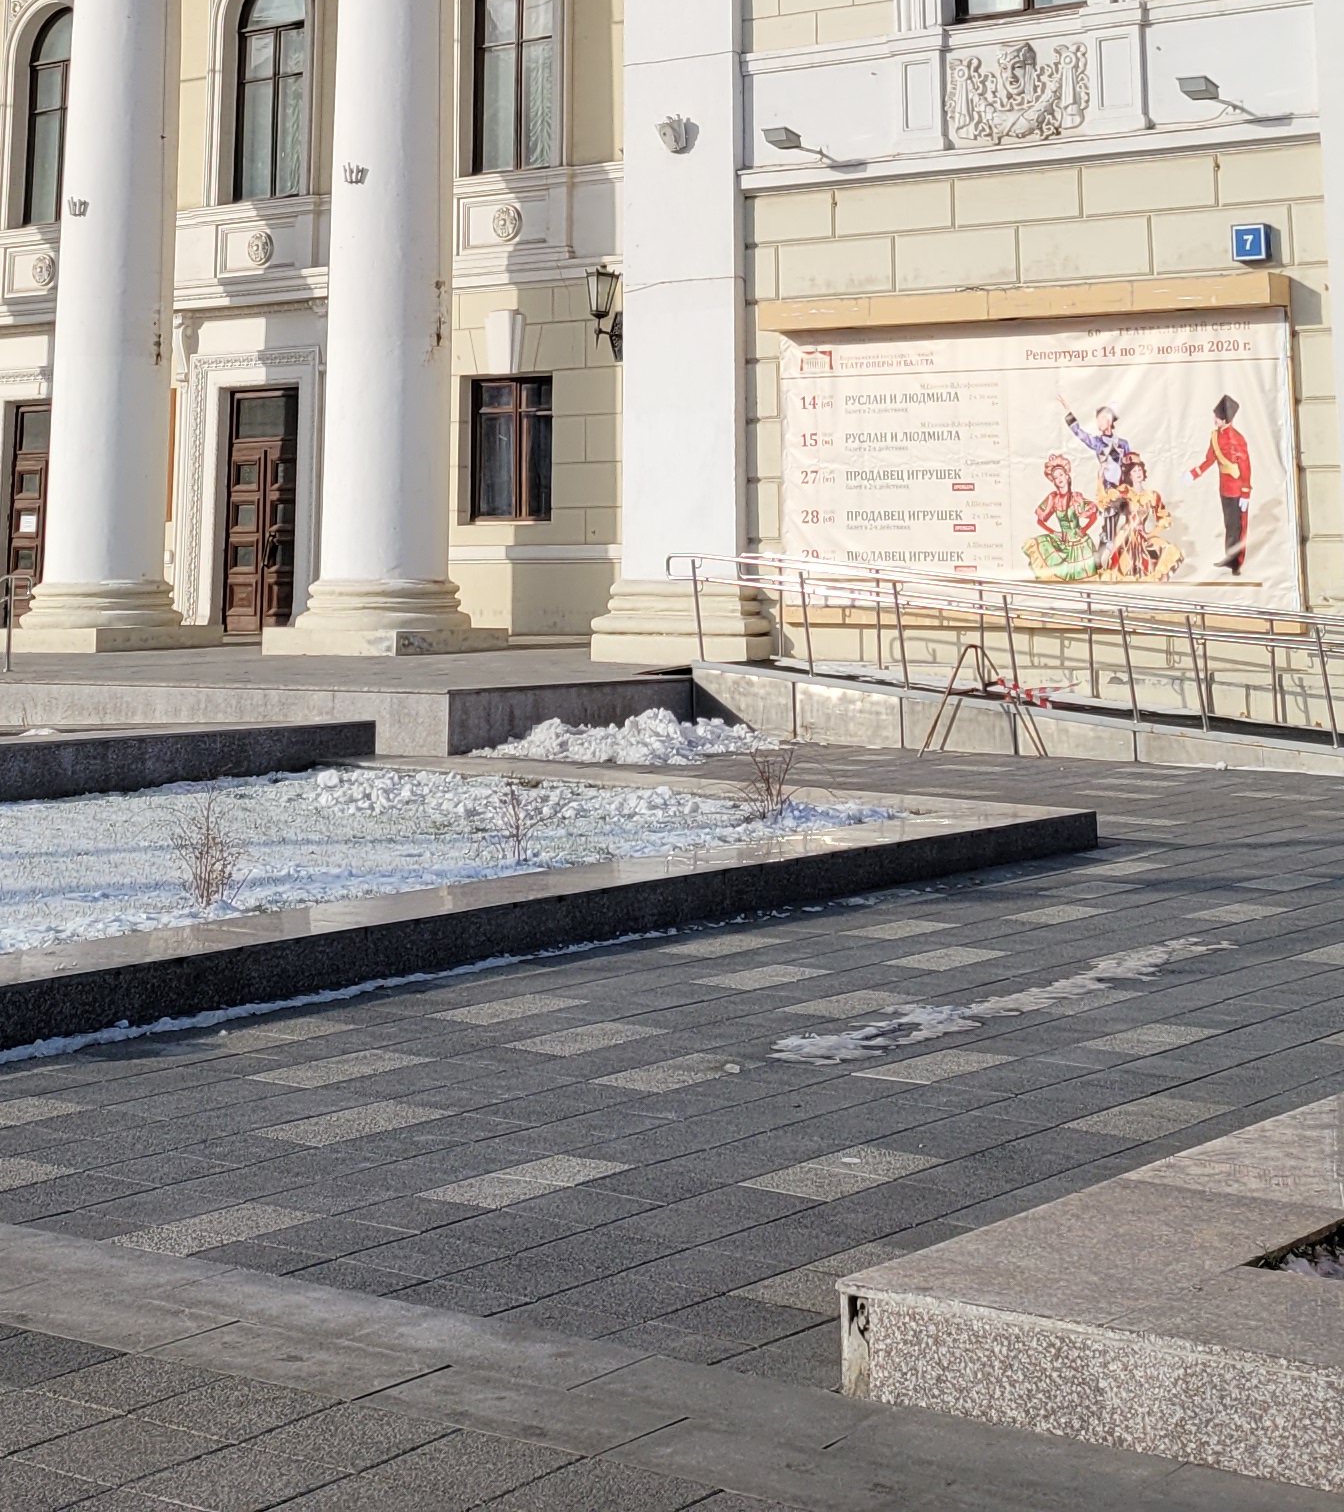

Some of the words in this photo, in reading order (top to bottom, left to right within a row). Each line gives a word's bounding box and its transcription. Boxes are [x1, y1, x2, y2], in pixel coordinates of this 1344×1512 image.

[1242, 234, 1254, 251] 7
[1211, 321, 1252, 332] СЕЗОН
[1025, 347, 1089, 362] Репертуар
[1091, 348, 1098, 358] с
[1101, 345, 1116, 358] 14
[1119, 347, 1136, 356] по
[1138, 344, 1153, 355] 29
[1157, 341, 1204, 357] ноября
[1207, 339, 1240, 353] 2020
[1243, 341, 1252, 351] г.
[839, 361, 864, 370] ТЕАТР
[866, 360, 894, 369] ОПЕРЫ
[896, 359, 902, 367] И
[903, 358, 935, 367] БАЛЕТА
[800, 395, 818, 409] 14
[845, 394, 887, 405] РУСЛАН
[890, 393, 897, 404] И
[900, 391, 960, 405] ЛЮДМИЛА
[801, 432, 818, 447] 15
[845, 432, 887, 443] РУСЛАН
[891, 432, 898, 442] И
[900, 430, 961, 443] ЛЮДМИЛА
[800, 470, 818, 484] 27
[846, 470, 905, 482] ПРОДАВЕЦ
[907, 468, 962, 480] ИГРУШЕК
[801, 509, 819, 524] 28
[846, 510, 906, 523] ПРОДАВЕЦ
[908, 510, 963, 521] ИГРУШЕК
[846, 551, 906, 563] ПРОДАВЕЦ
[909, 550, 964, 562] ИГРУШЕК
